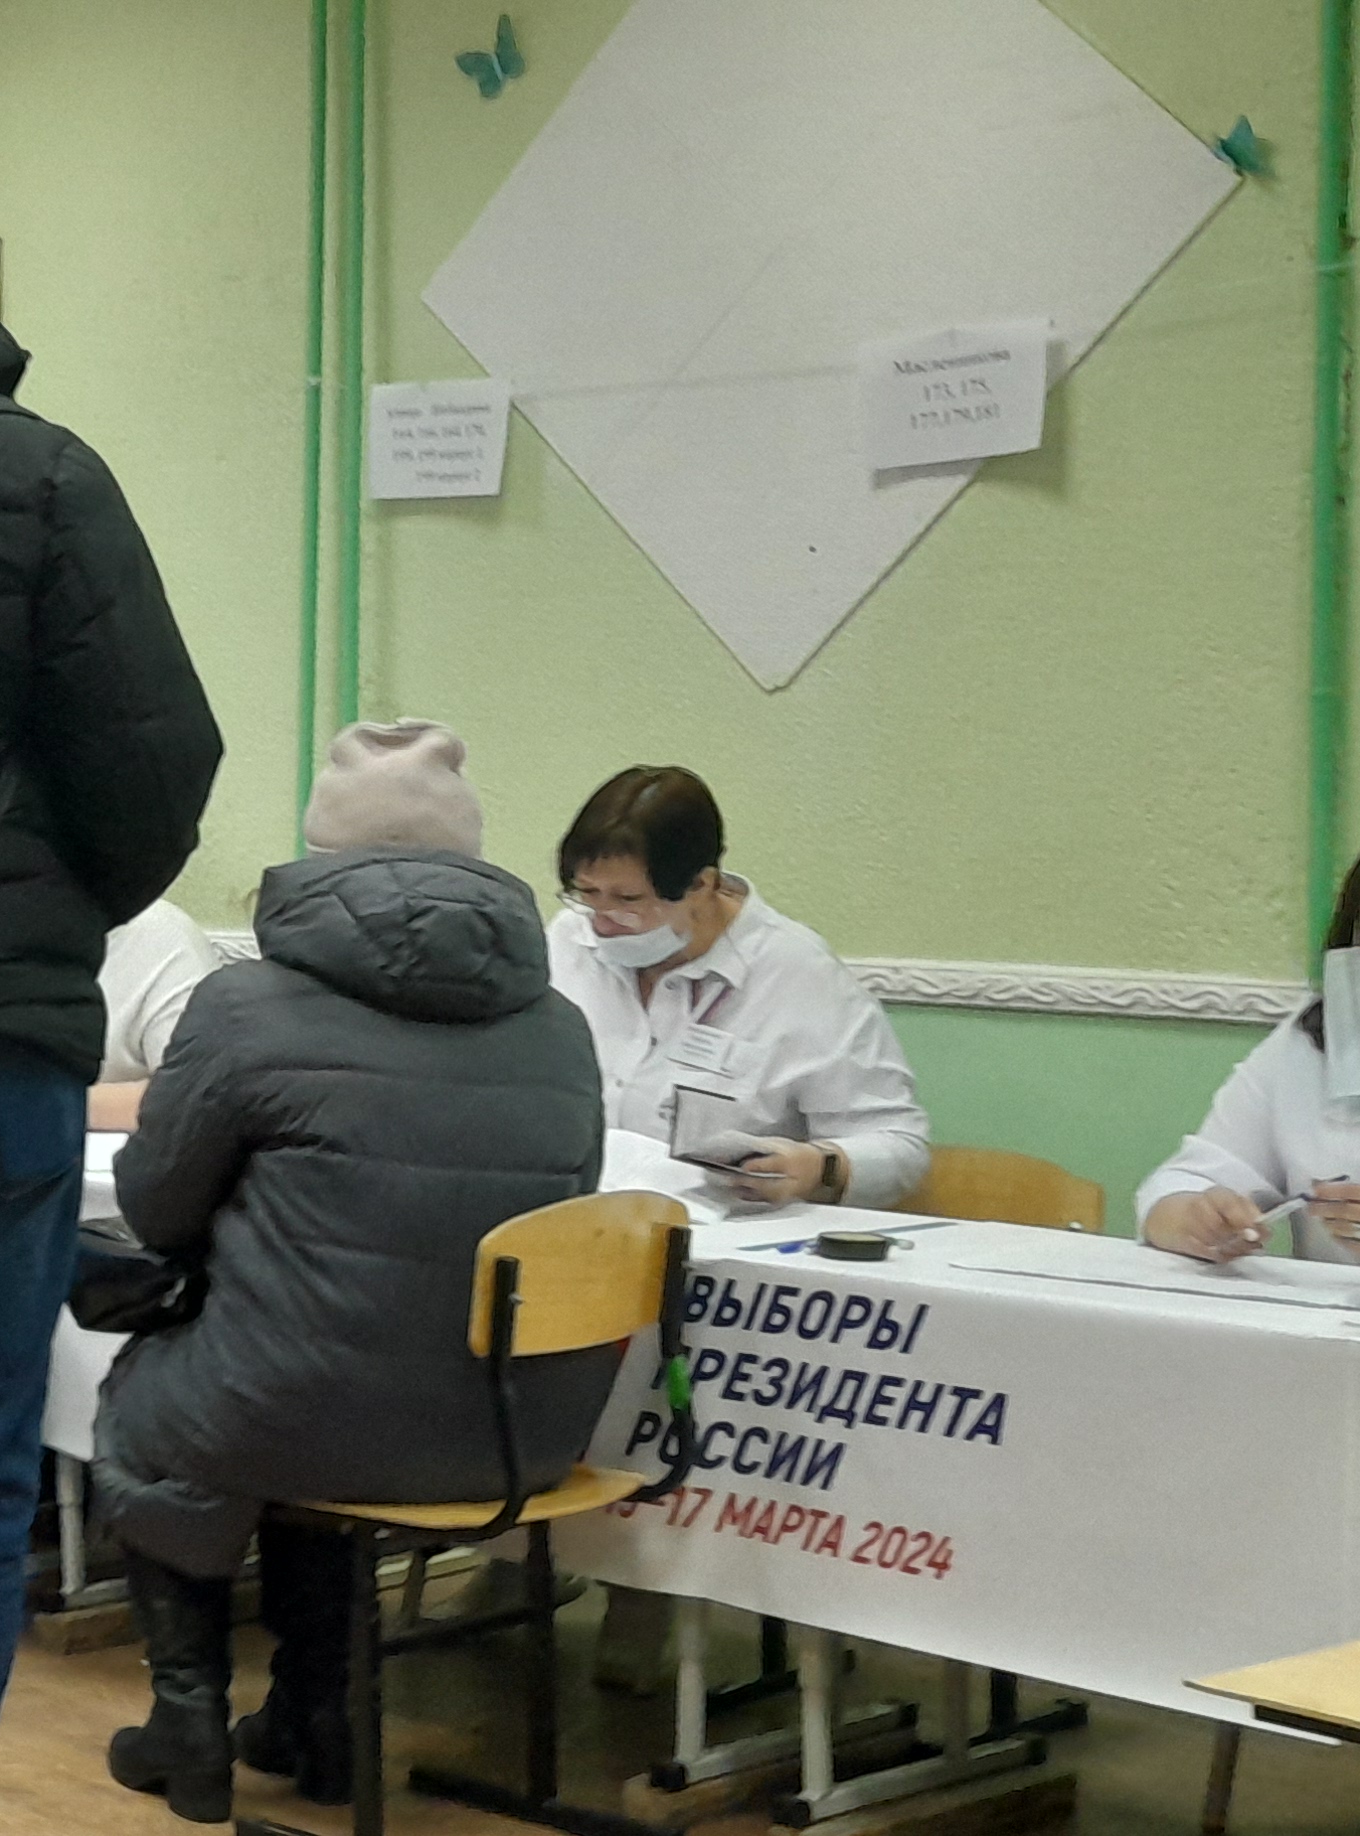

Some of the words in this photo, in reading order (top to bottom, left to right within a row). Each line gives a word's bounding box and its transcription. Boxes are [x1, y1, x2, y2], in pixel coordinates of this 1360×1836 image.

[681, 1274, 930, 1355] ВЫБОРЫ
[713, 1492, 846, 1557] МАРТА
[850, 1520, 955, 1580] 2024
